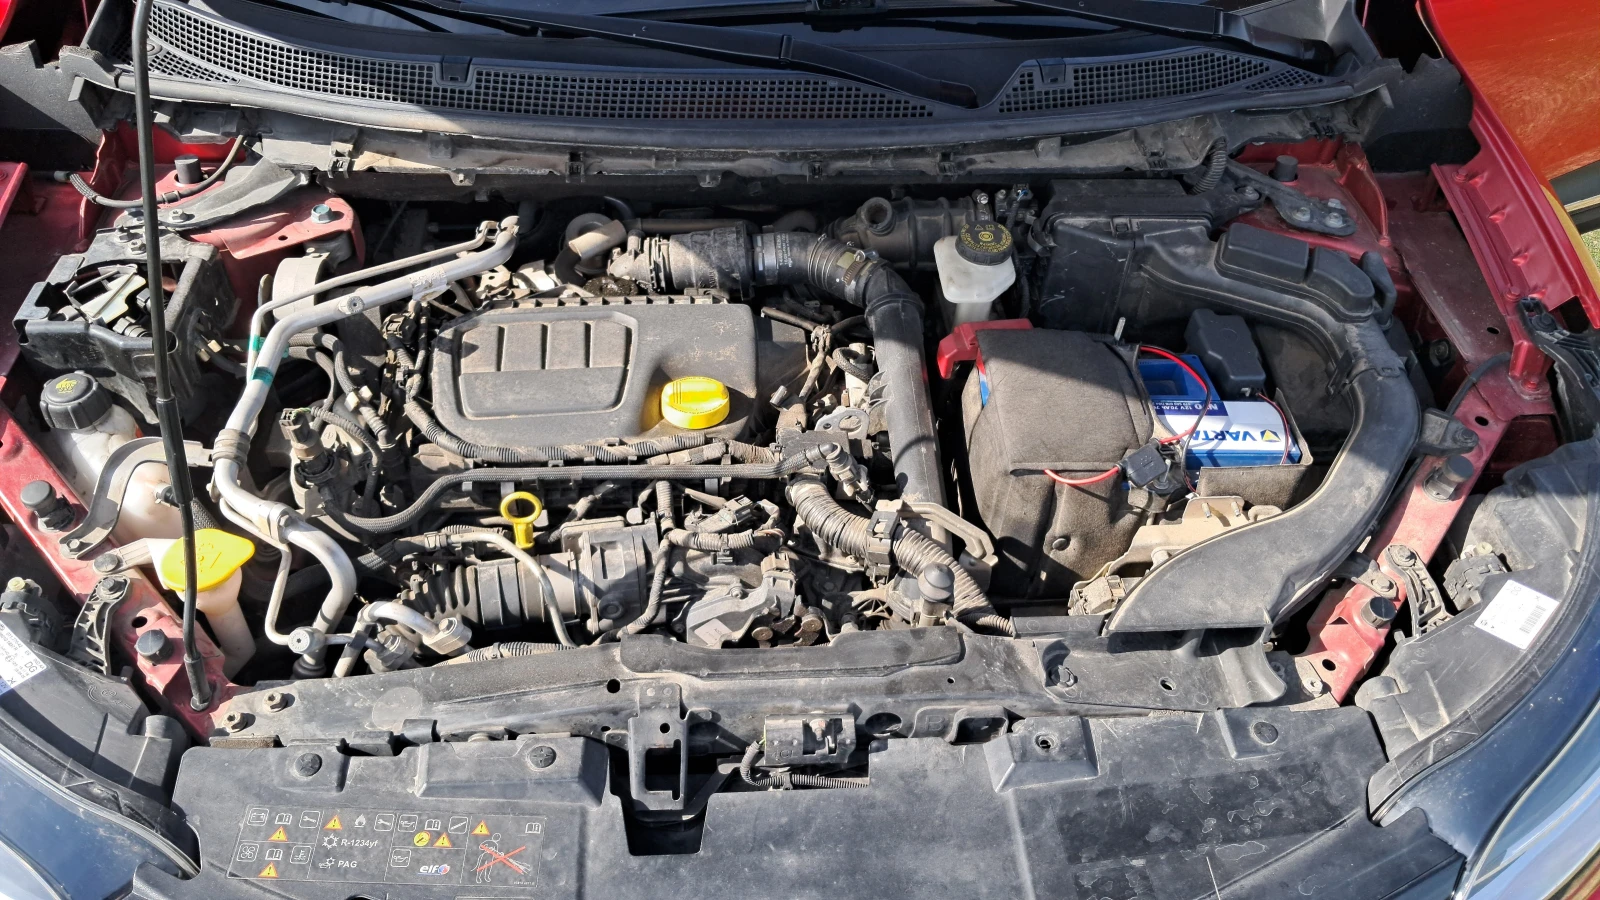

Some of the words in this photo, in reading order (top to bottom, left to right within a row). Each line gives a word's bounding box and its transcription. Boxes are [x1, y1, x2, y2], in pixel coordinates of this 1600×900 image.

[24, 661, 38, 673] DG
[340, 838, 379, 849] R-1234yf
[337, 860, 358, 869] PAG
[419, 864, 440, 874] elf
